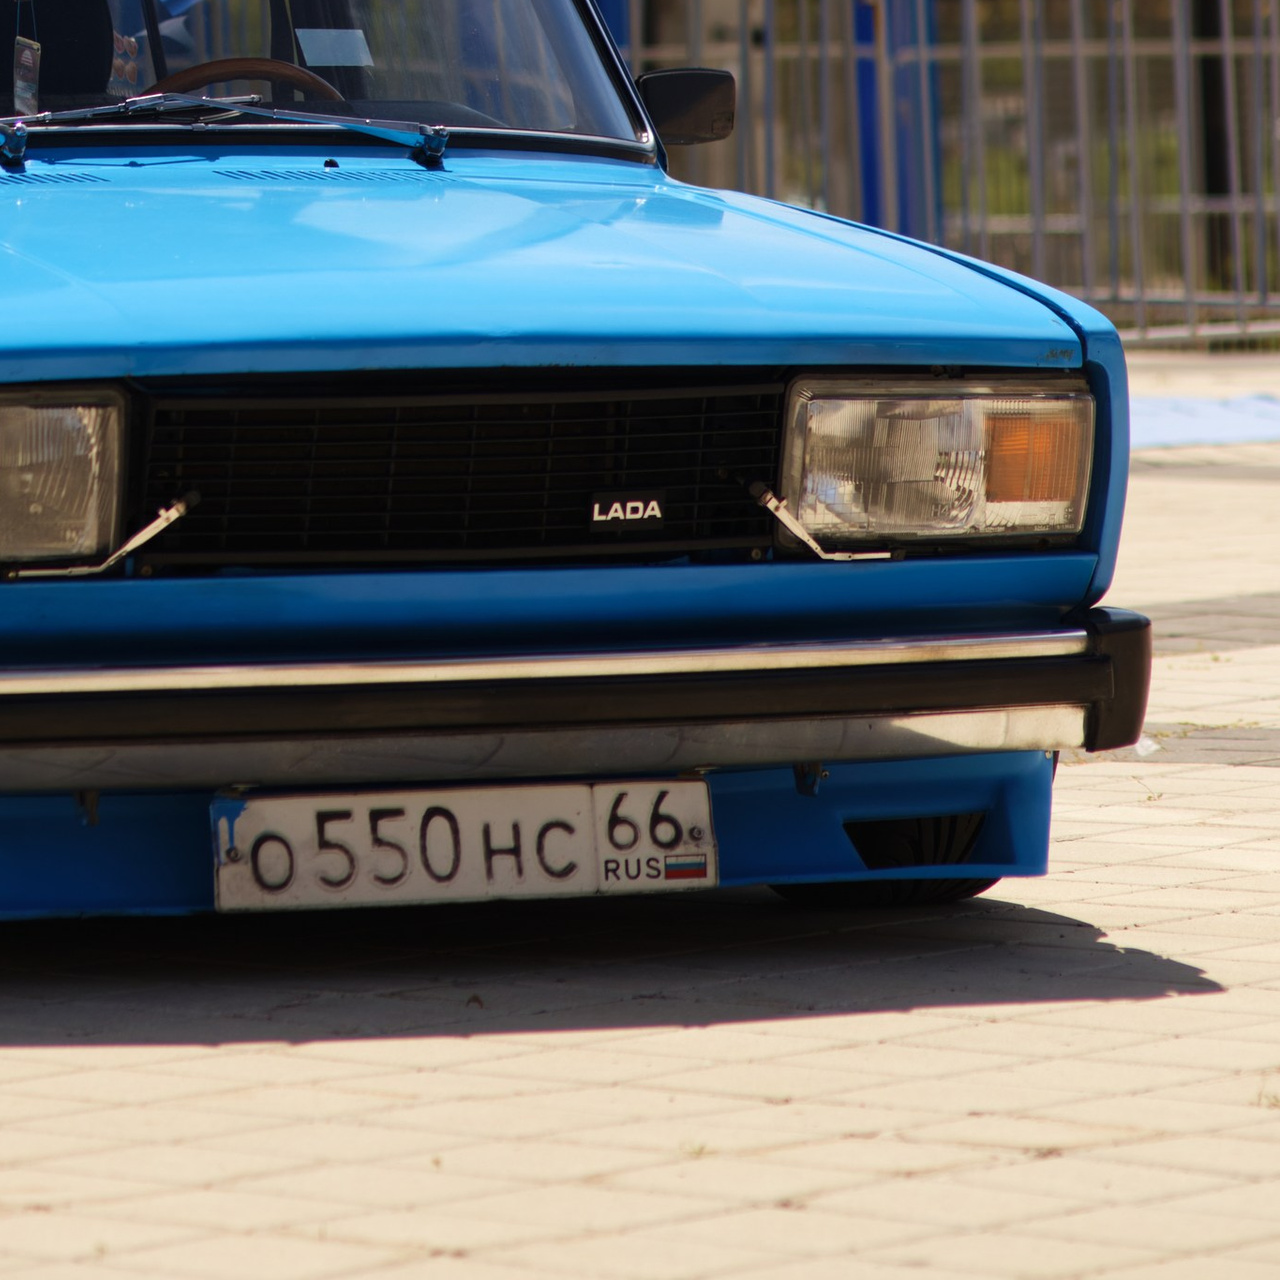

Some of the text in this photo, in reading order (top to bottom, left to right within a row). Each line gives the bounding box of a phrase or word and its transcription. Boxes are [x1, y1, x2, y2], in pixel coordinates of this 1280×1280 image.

[593, 500, 662, 521] LADA
[931, 504, 949, 518] H4
[606, 790, 682, 850] 66
[604, 854, 662, 881] RUS
